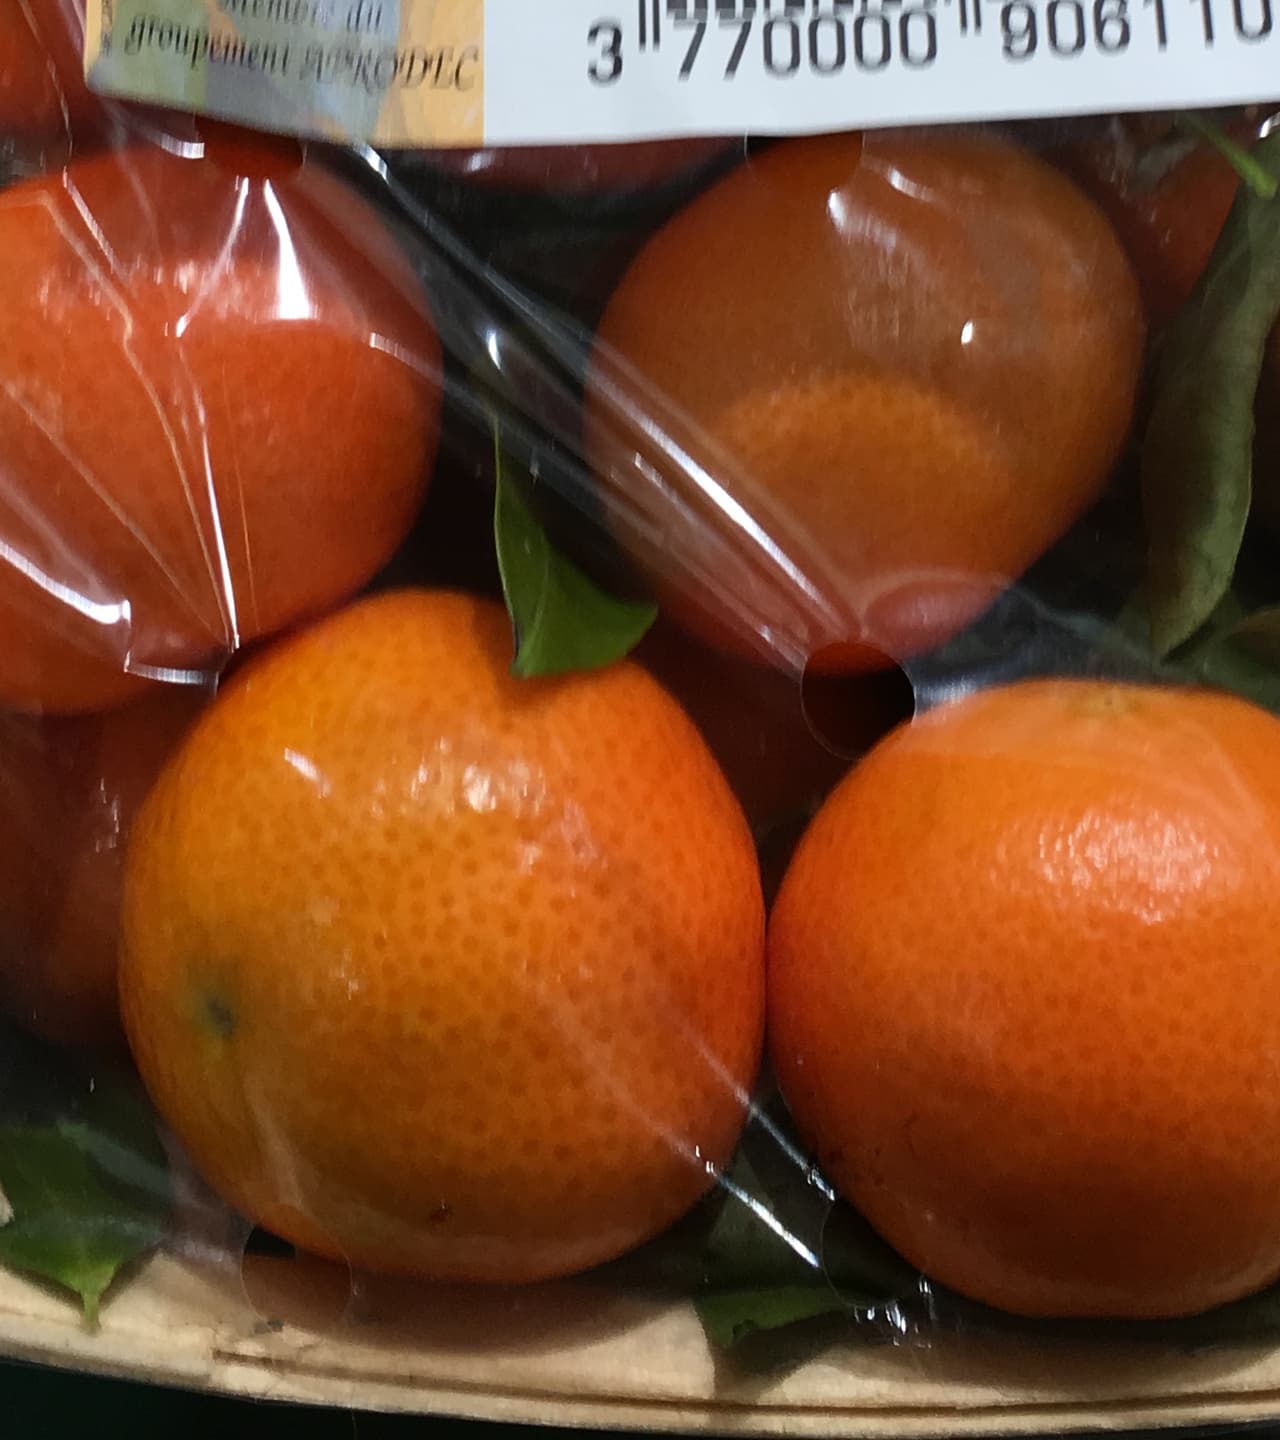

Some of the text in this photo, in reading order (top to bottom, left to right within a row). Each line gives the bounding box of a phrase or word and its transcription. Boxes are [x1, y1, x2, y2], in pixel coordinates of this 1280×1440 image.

[122, 11, 290, 77] groupement
[585, 19, 624, 87] 3
[670, 6, 940, 83] 770000
